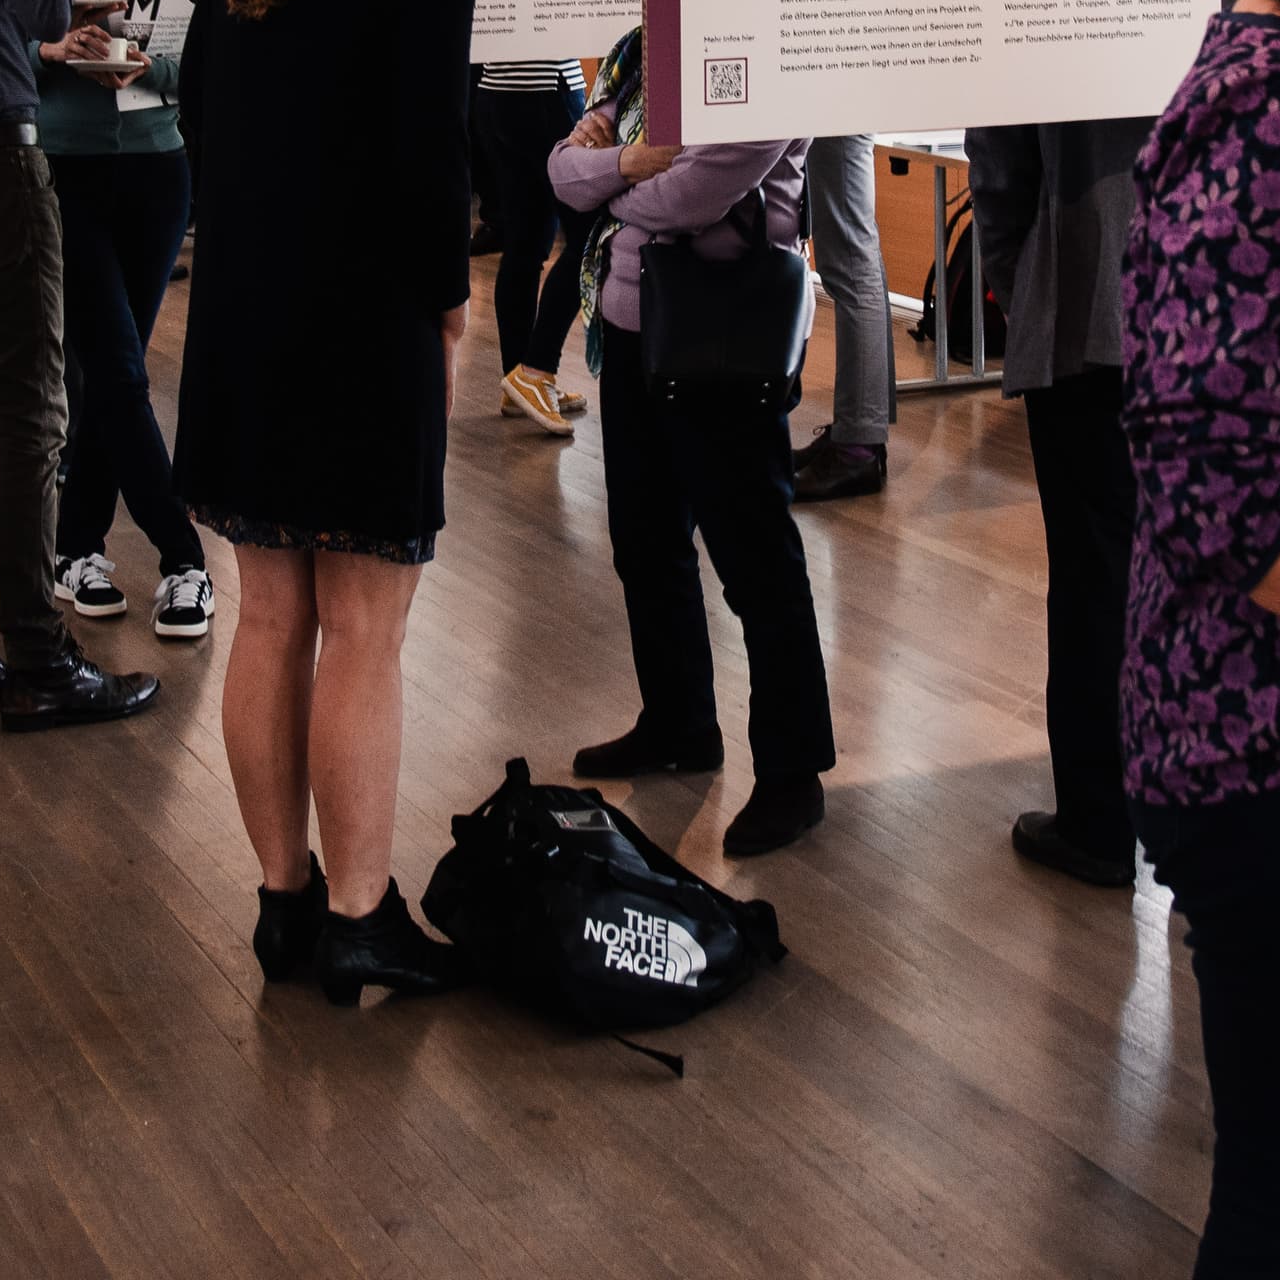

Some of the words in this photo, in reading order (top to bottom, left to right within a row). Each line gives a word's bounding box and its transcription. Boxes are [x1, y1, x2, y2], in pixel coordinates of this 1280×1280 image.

[584, 917, 667, 959] NORTH
[624, 907, 667, 938] THE
[605, 945, 666, 980] FACE
